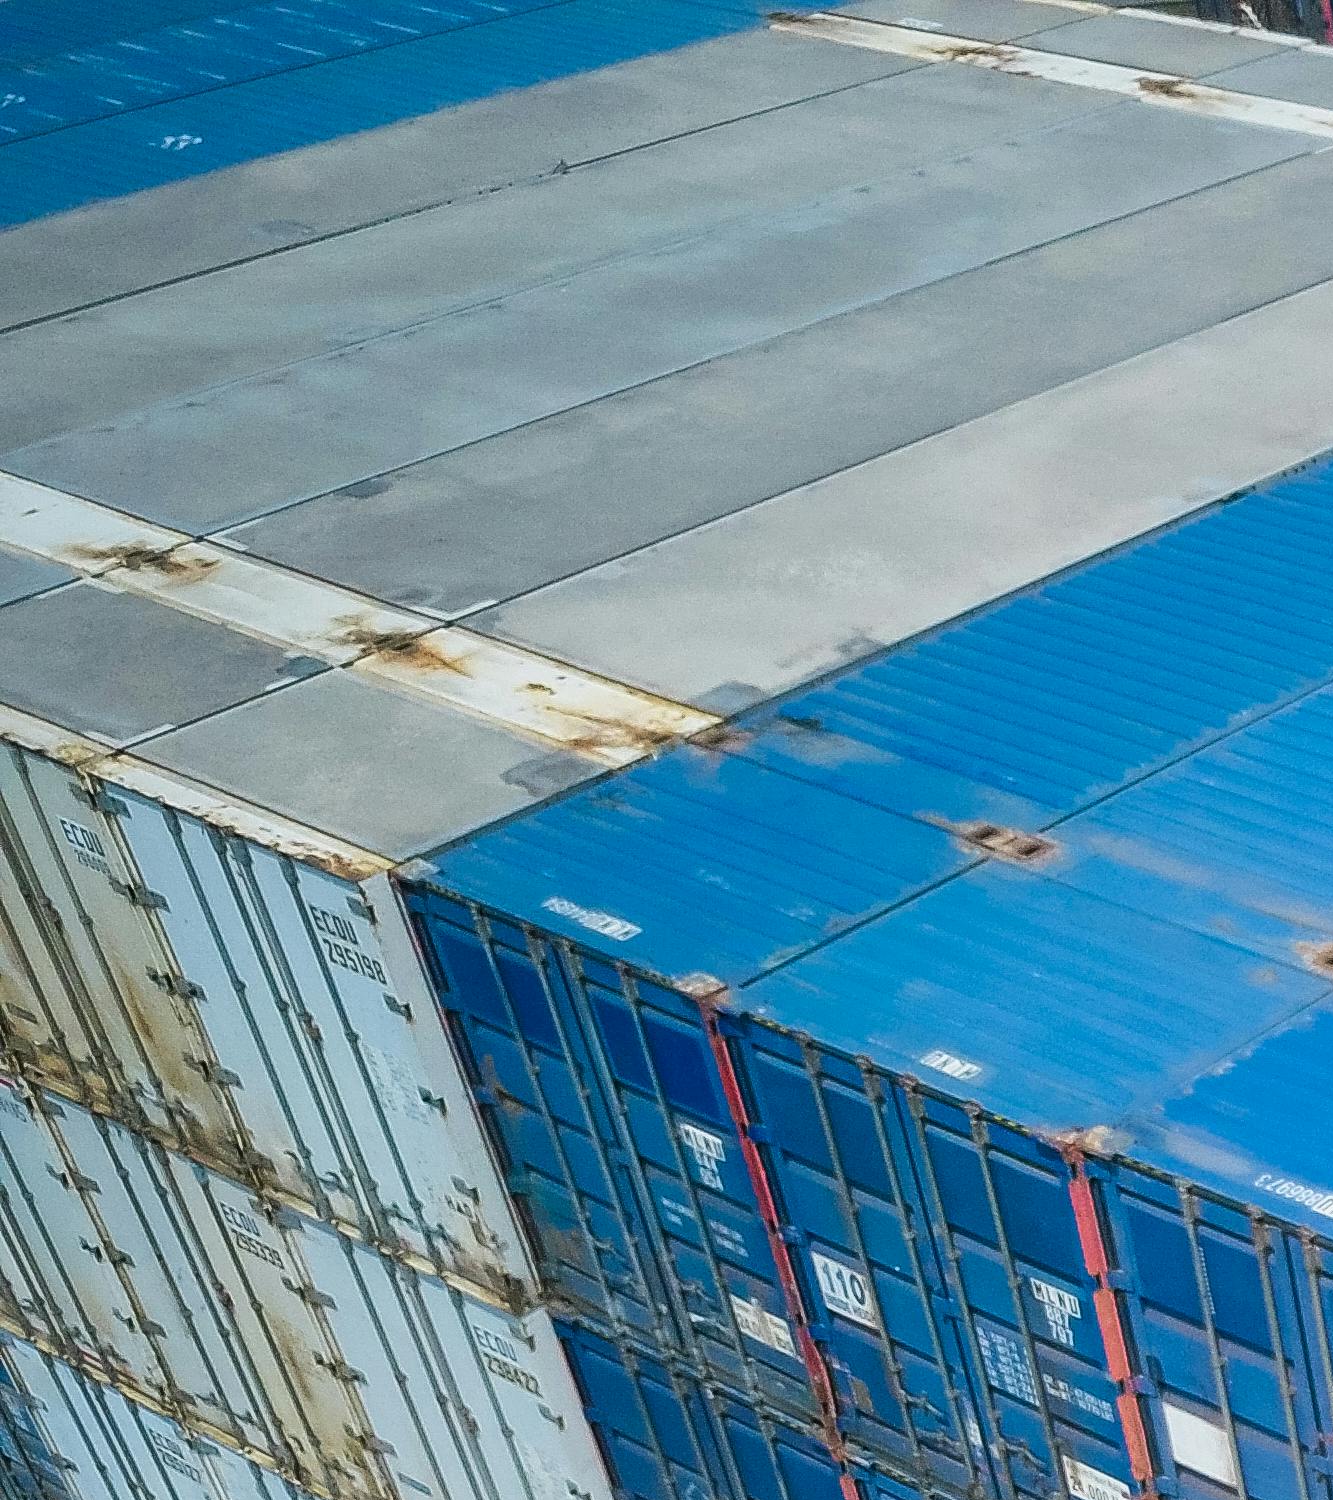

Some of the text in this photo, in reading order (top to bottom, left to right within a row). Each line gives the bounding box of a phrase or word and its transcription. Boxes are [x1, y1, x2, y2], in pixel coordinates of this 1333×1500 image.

[322, 938, 387, 985] 295198
[1254, 1172, 1318, 1207] 886973
[822, 1261, 866, 1307] 110
[1031, 1277, 1081, 1318] MLNU
